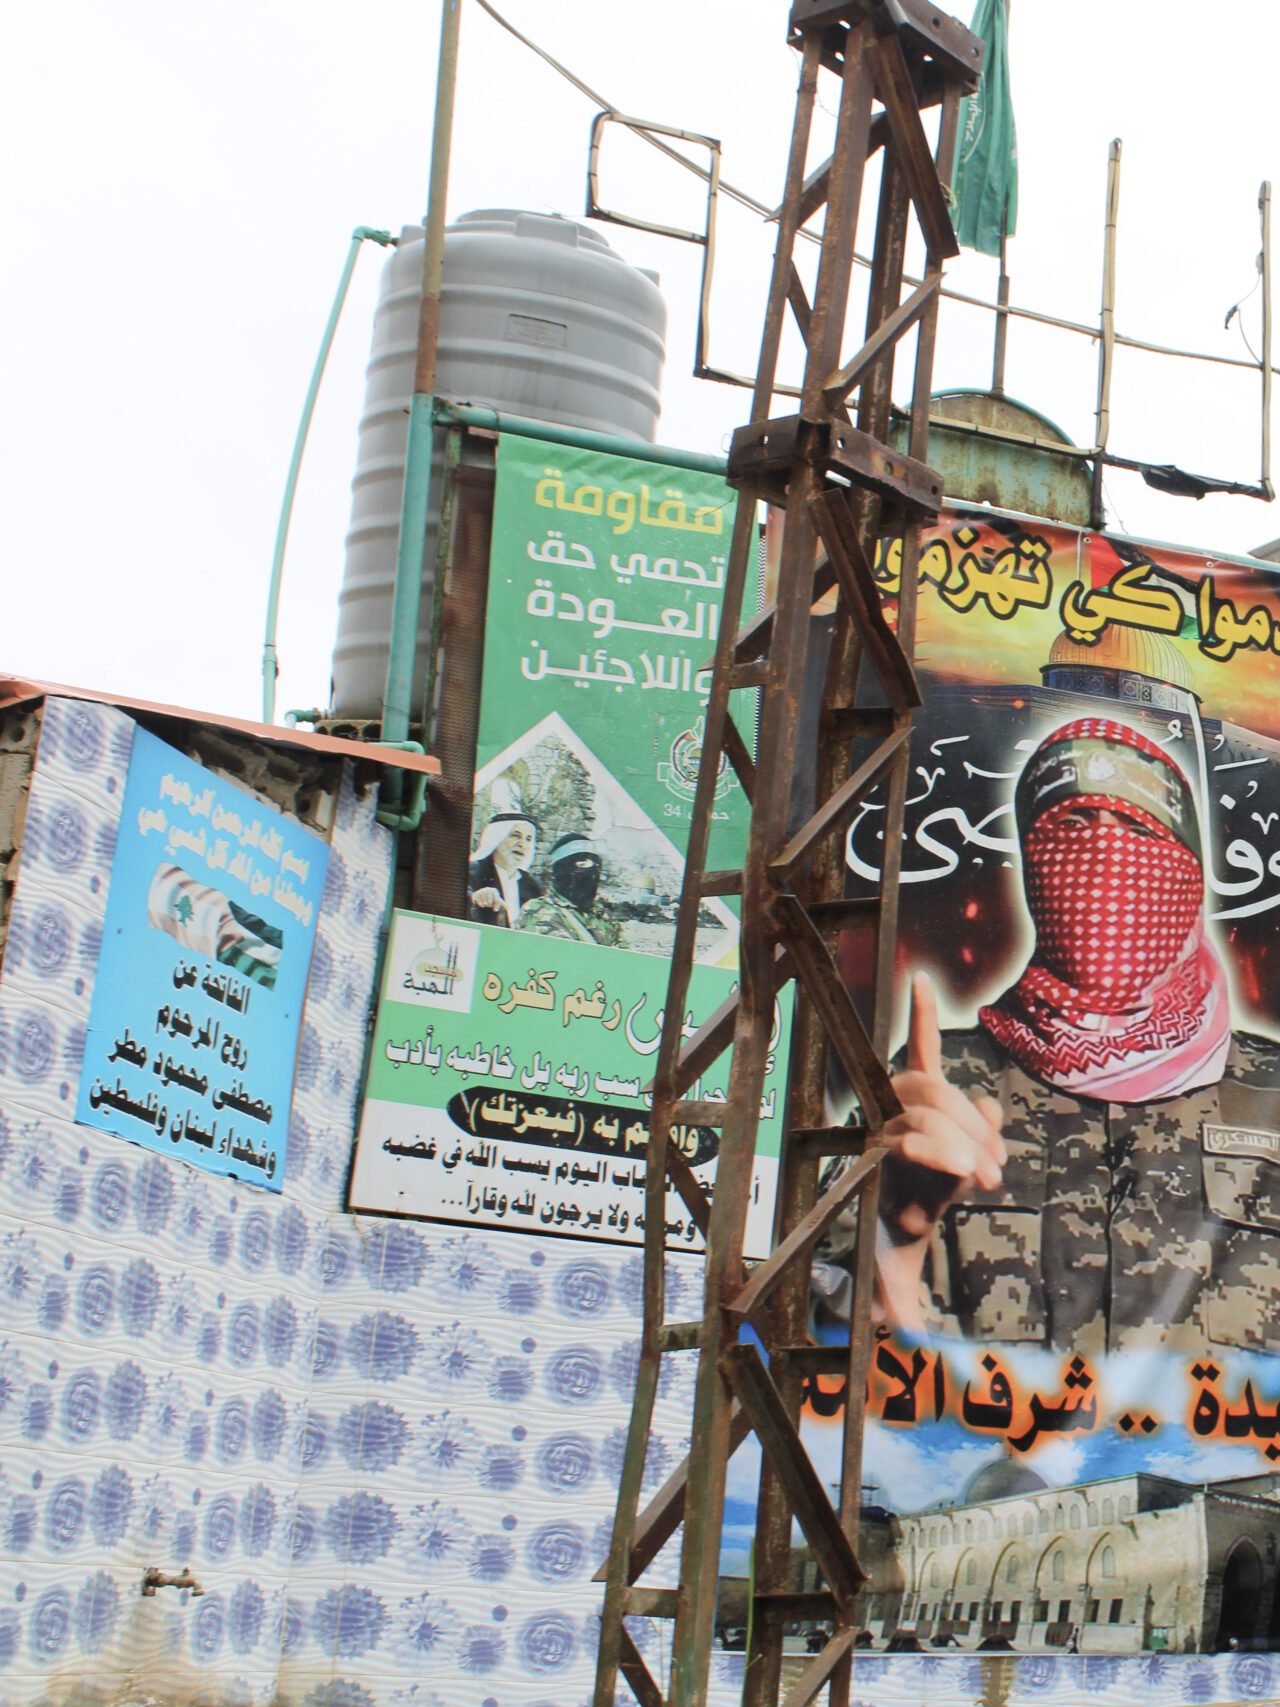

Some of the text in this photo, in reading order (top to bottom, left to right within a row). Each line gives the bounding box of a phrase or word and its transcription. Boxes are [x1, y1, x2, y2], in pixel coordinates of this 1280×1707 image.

[535, 467, 724, 535] مقاومة
[527, 530, 725, 588] تحمي حق
[527, 579, 718, 640] العودة
[1060, 562, 1186, 647] كي
[663, 803, 681, 817] 34
[173, 959, 250, 1015] الفاتحة عن
[482, 968, 559, 1014] كفره
[564, 980, 622, 1031] رغم
[156, 1004, 248, 1071] روح المرحوم
[385, 1025, 443, 1075] بأدب
[107, 1028, 273, 1125] مصطفى محمود مطر
[445, 1042, 517, 1080] خاطبه
[520, 1051, 551, 1092] بل
[554, 1062, 590, 1098] ربه
[594, 1071, 641, 1100] سب
[90, 1077, 276, 1180] وشهداء لبنان وفلسطين
[382, 1134, 437, 1161] غضبه
[592, 1113, 619, 1147] به
[442, 1138, 462, 1174] في
[465, 1140, 497, 1168] الله
[502, 1154, 550, 1181] يسب
[555, 1160, 608, 1187] اليوم
[510, 1188, 536, 1215] لله
[540, 1200, 603, 1230] يرجون
[608, 1203, 630, 1233] ولا
[961, 1354, 1097, 1453] شرف
